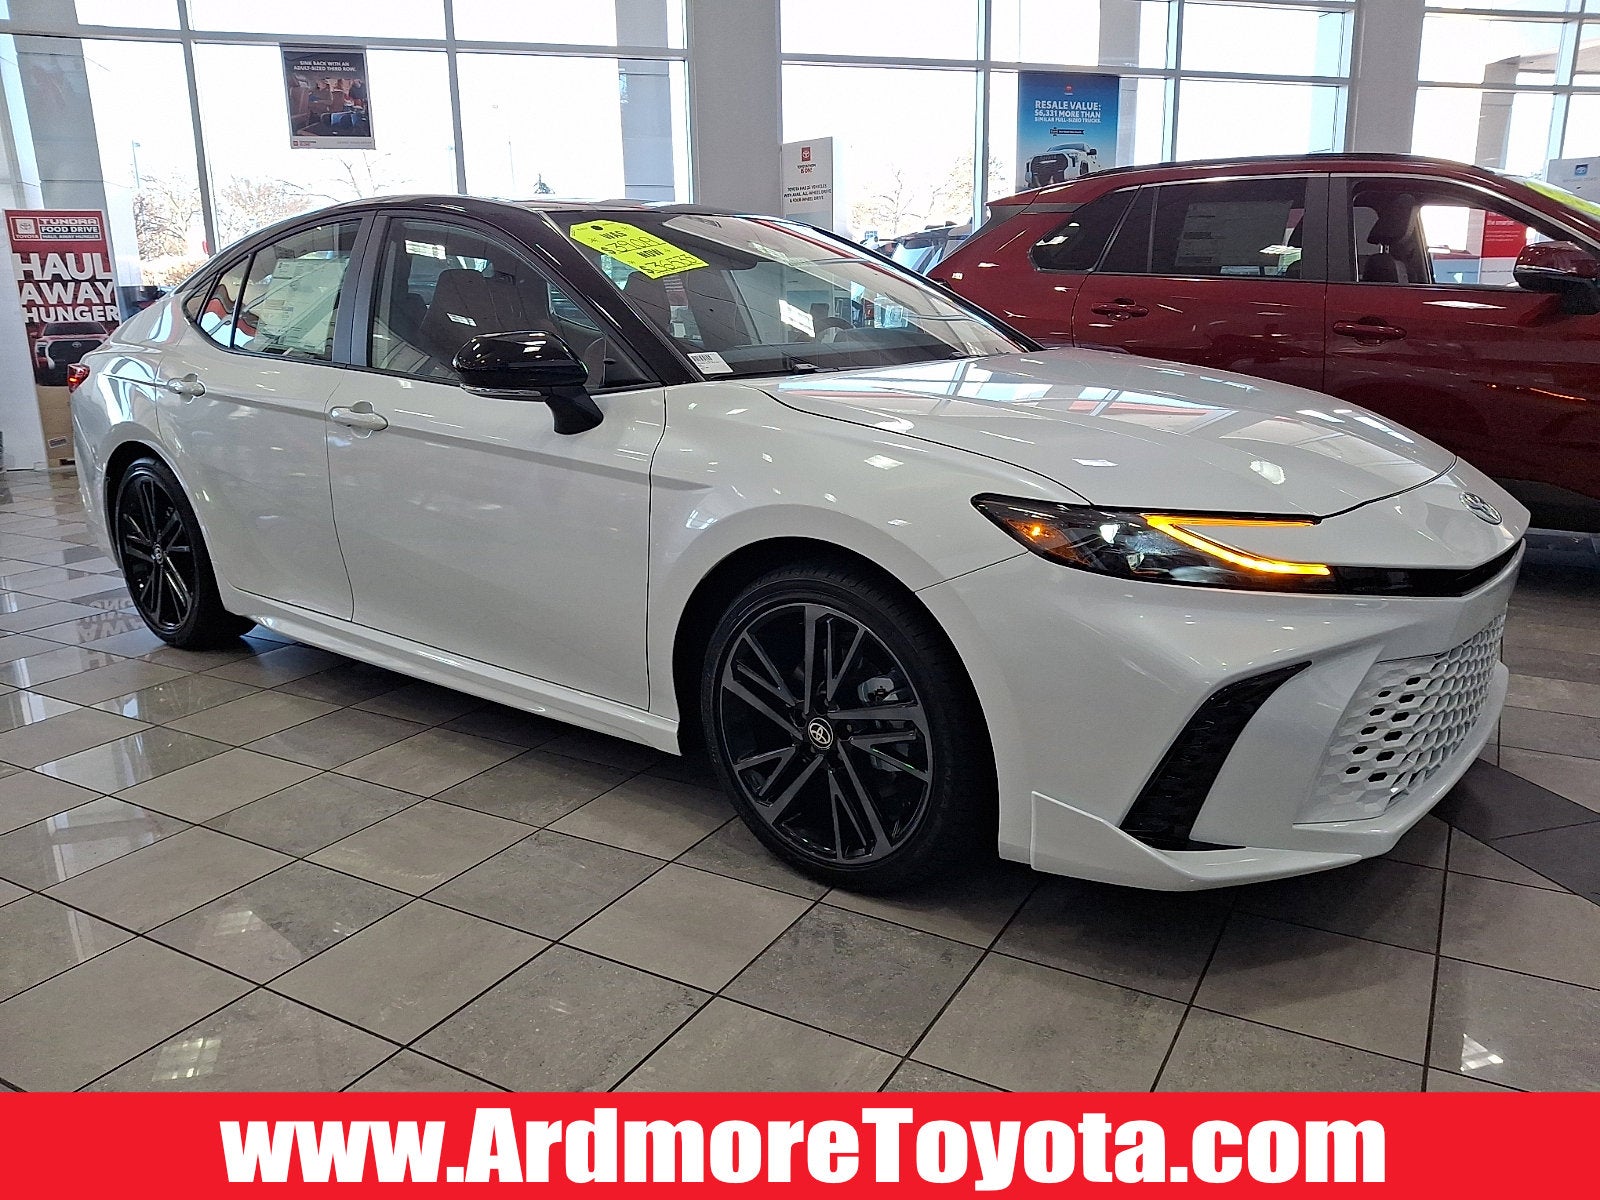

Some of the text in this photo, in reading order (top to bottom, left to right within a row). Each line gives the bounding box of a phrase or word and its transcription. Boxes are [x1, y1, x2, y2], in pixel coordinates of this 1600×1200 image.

[1035, 100, 1101, 111] RESALE VALUE:
[1058, 110, 1080, 118] MORE
[1080, 110, 1101, 119] THAN
[600, 230, 627, 240] WAS
[636, 248, 664, 259] NOW
[12, 253, 114, 280] HAUL
[20, 282, 114, 304] AWAY
[22, 306, 119, 322] HUNGER
